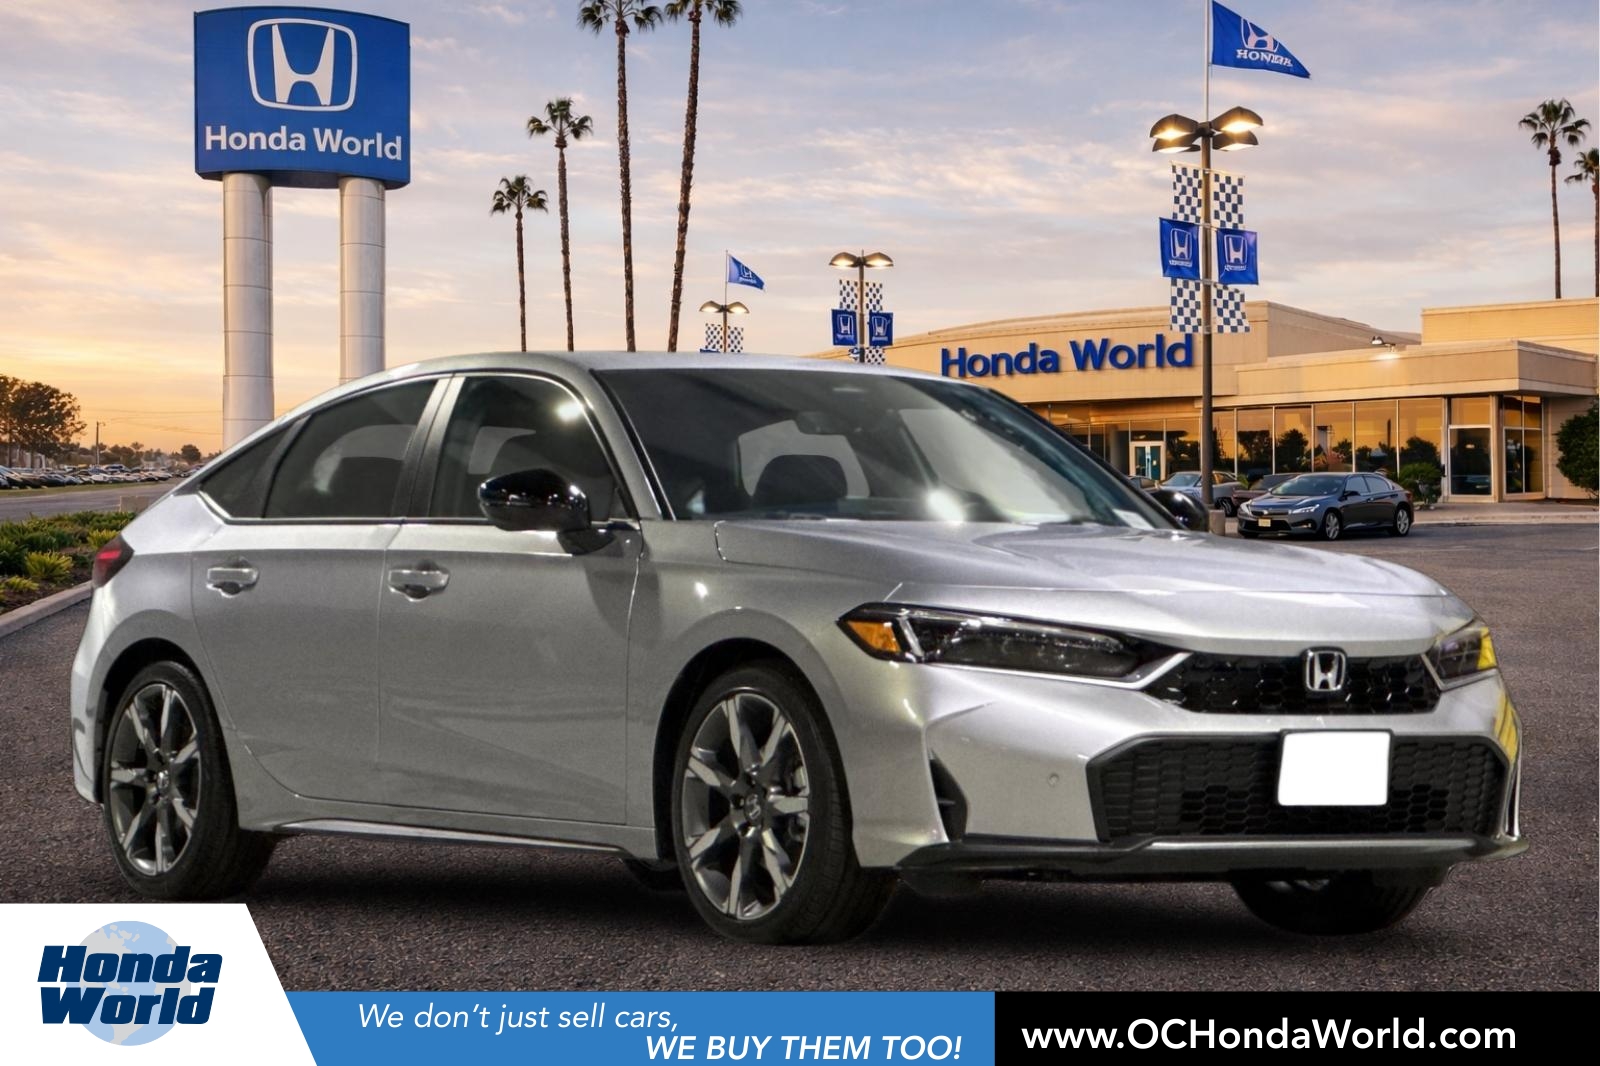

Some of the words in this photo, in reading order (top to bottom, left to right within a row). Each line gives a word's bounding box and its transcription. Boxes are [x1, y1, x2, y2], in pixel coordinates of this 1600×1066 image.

[205, 125, 306, 151] Honda
[313, 128, 402, 160] World
[941, 342, 1061, 377] Honda
[1069, 333, 1195, 371] World
